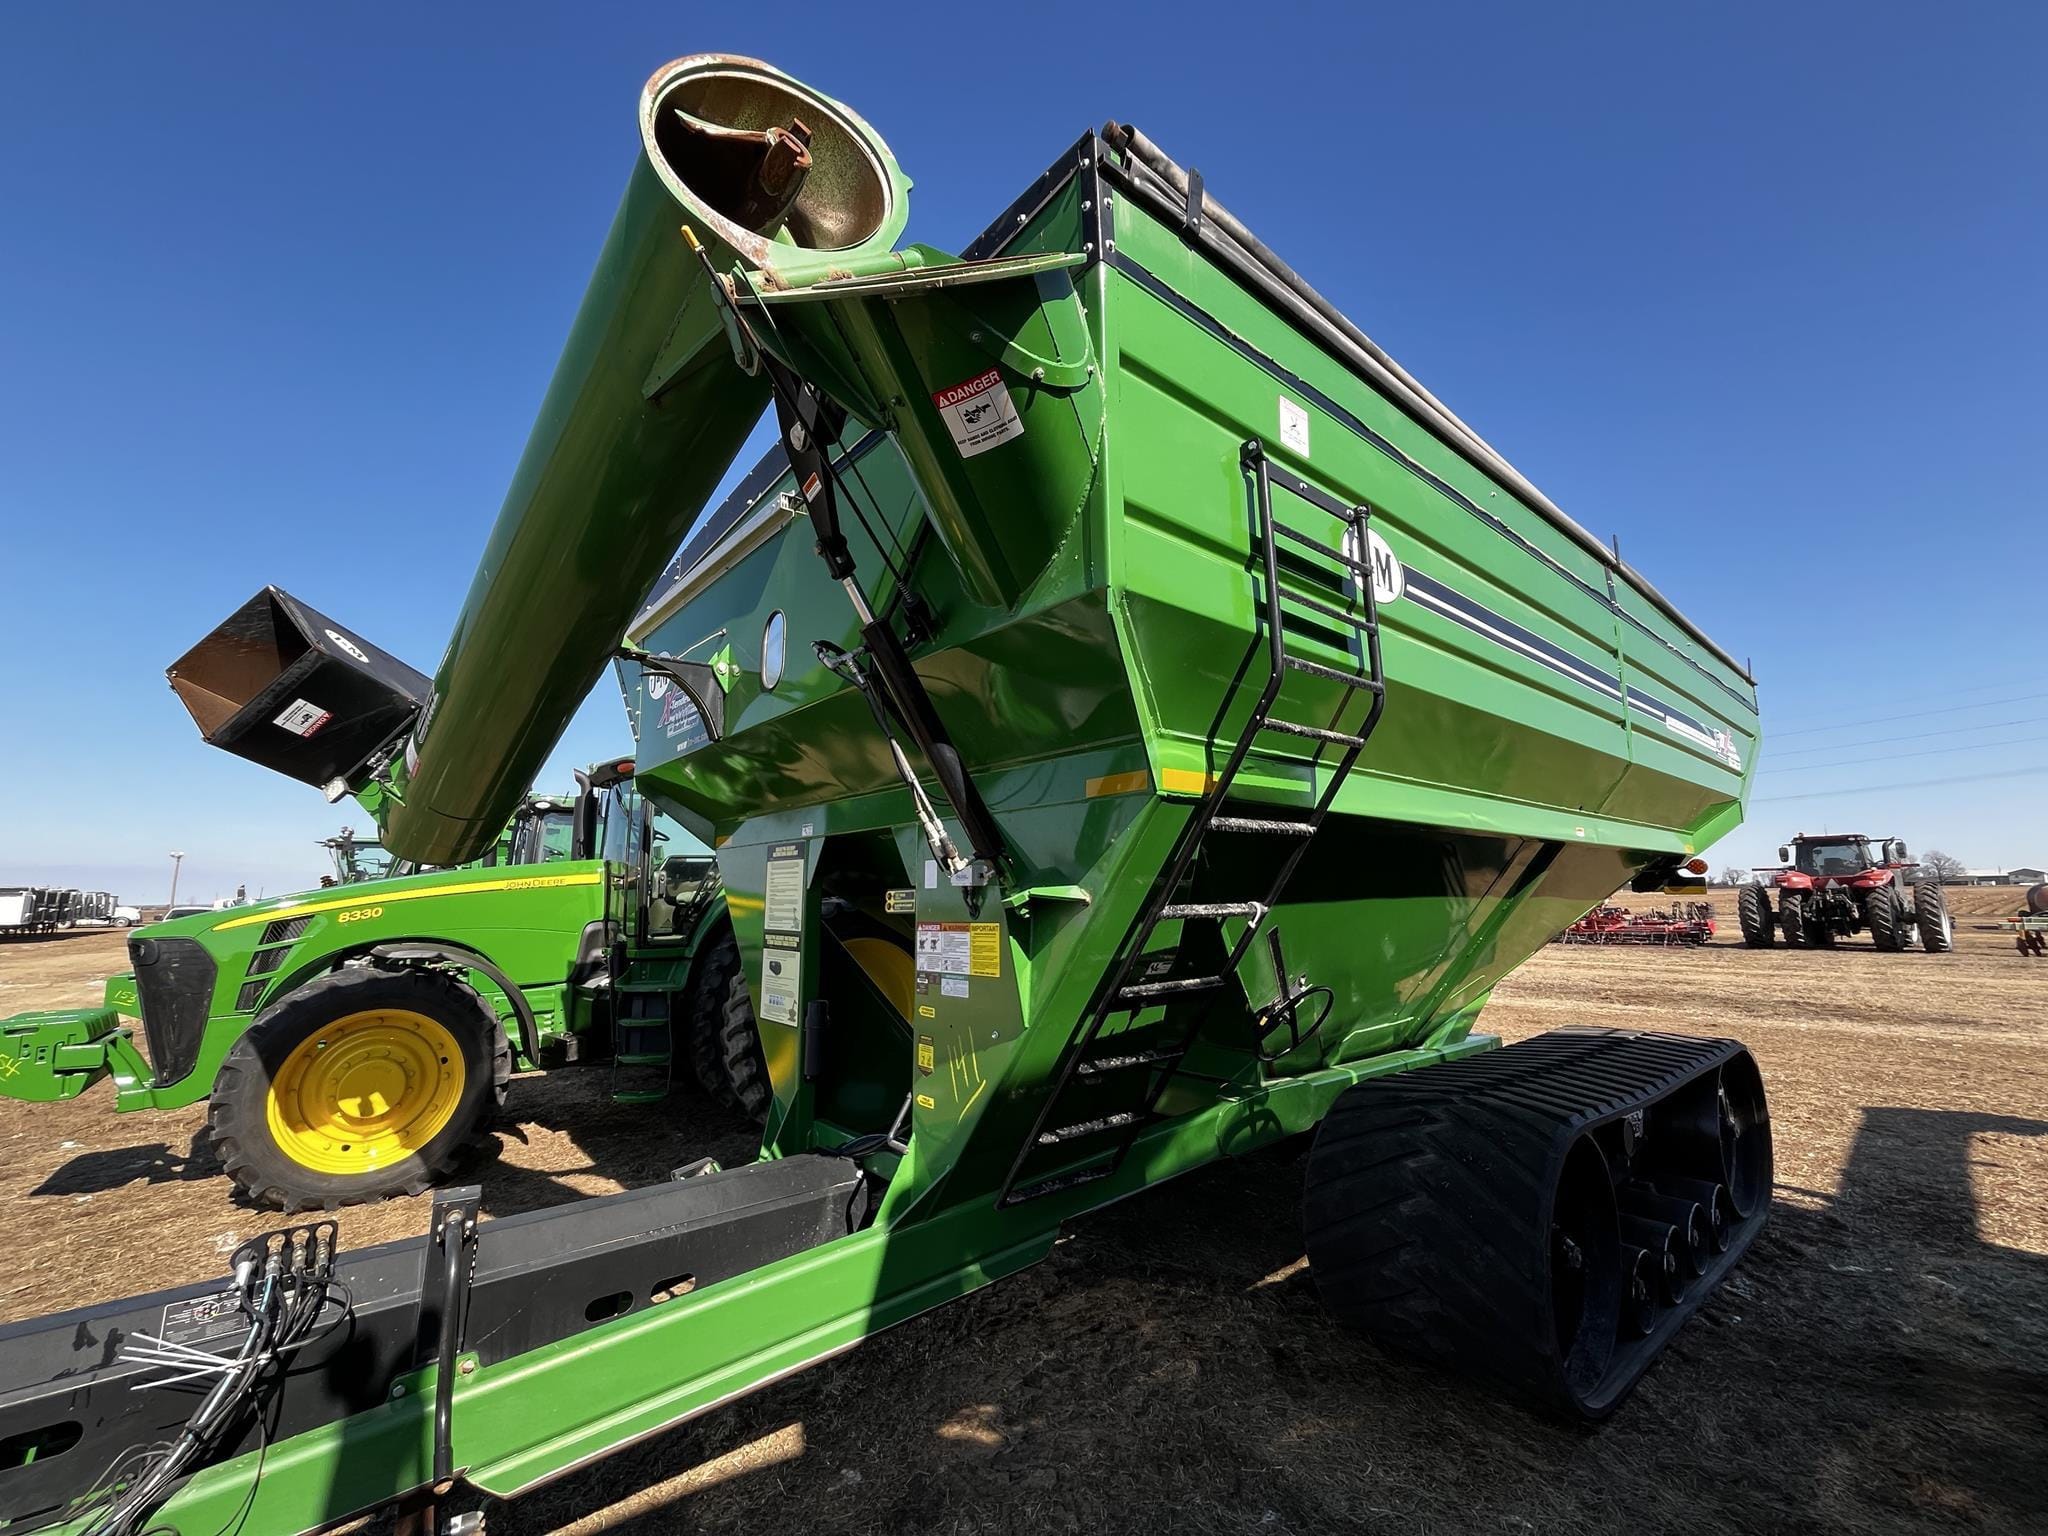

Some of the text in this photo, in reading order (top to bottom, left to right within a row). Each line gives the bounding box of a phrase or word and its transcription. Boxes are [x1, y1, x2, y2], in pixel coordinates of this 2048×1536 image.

[947, 370, 1001, 403] DANGER
[303, 717, 328, 738] DANGER
[504, 878, 566, 890] JOHN DEERE
[337, 907, 384, 923] 8330
